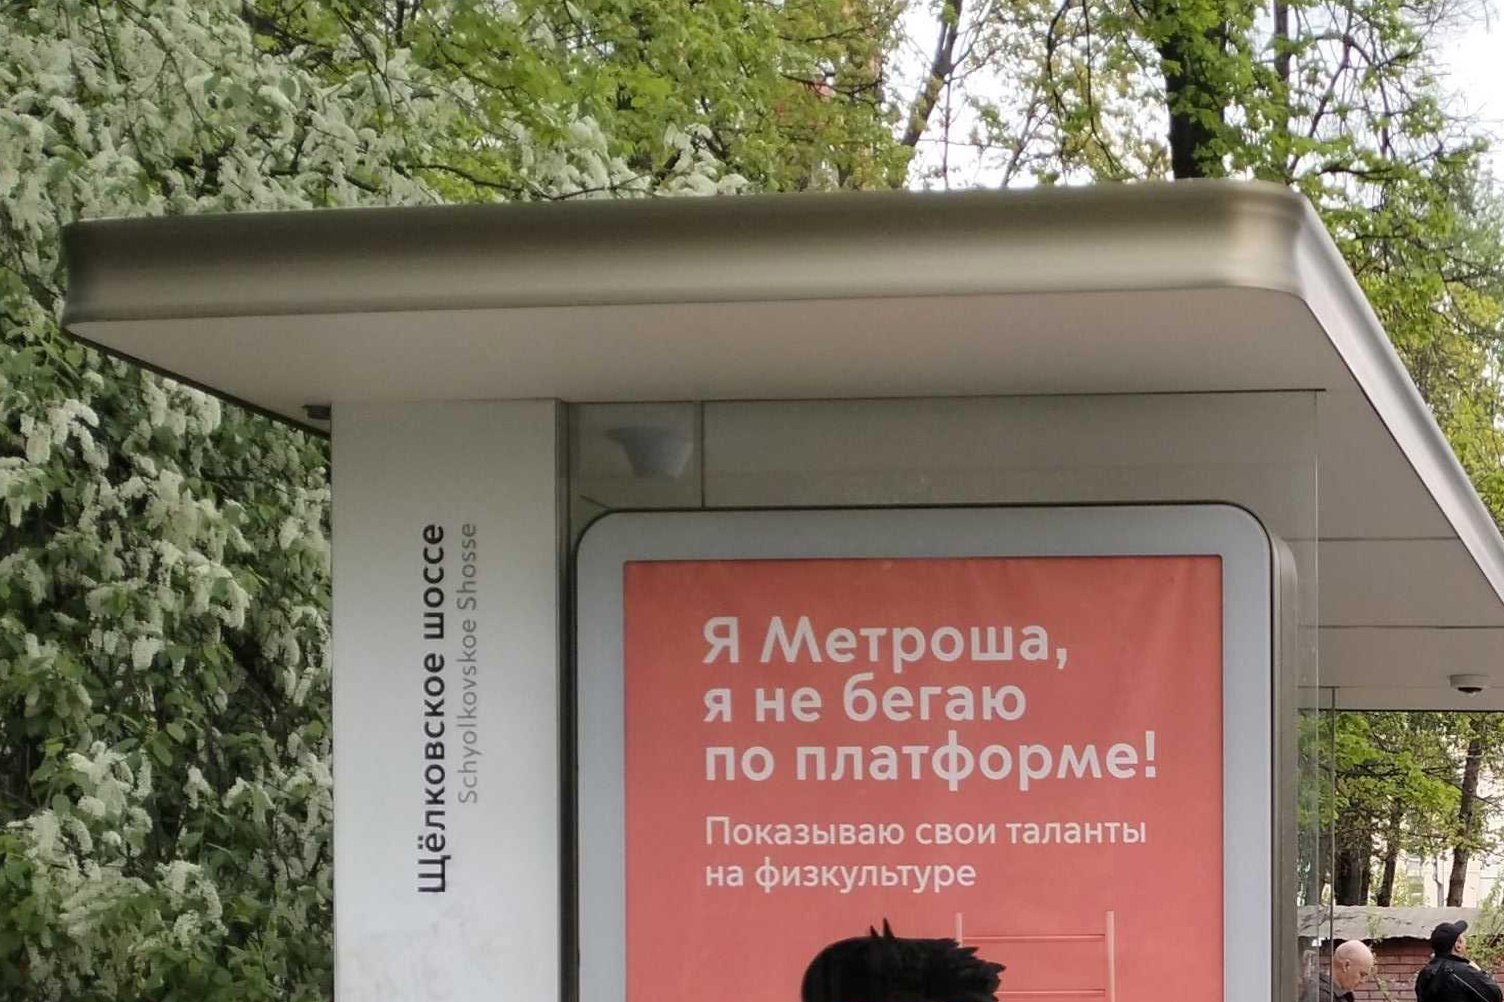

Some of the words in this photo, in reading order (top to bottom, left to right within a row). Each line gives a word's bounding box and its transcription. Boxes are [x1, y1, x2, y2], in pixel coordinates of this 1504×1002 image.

[423, 523, 446, 640] шоссе
[456, 522, 477, 609] Shosse
[703, 616, 740, 663] Я
[760, 615, 1067, 673] Метроша,
[457, 619, 482, 804] Schyolkovskoe
[703, 688, 732, 722] я
[756, 686, 822, 722] не
[843, 672, 1026, 721] бегаю
[417, 652, 452, 893] Щёлковское
[706, 745, 774, 781] по
[798, 730, 1157, 791] платформе!
[706, 816, 904, 846] Показываю
[915, 820, 996, 845] свои
[1006, 818, 1147, 844] таланты
[706, 861, 744, 887] на
[755, 857, 977, 893] физкультуре
